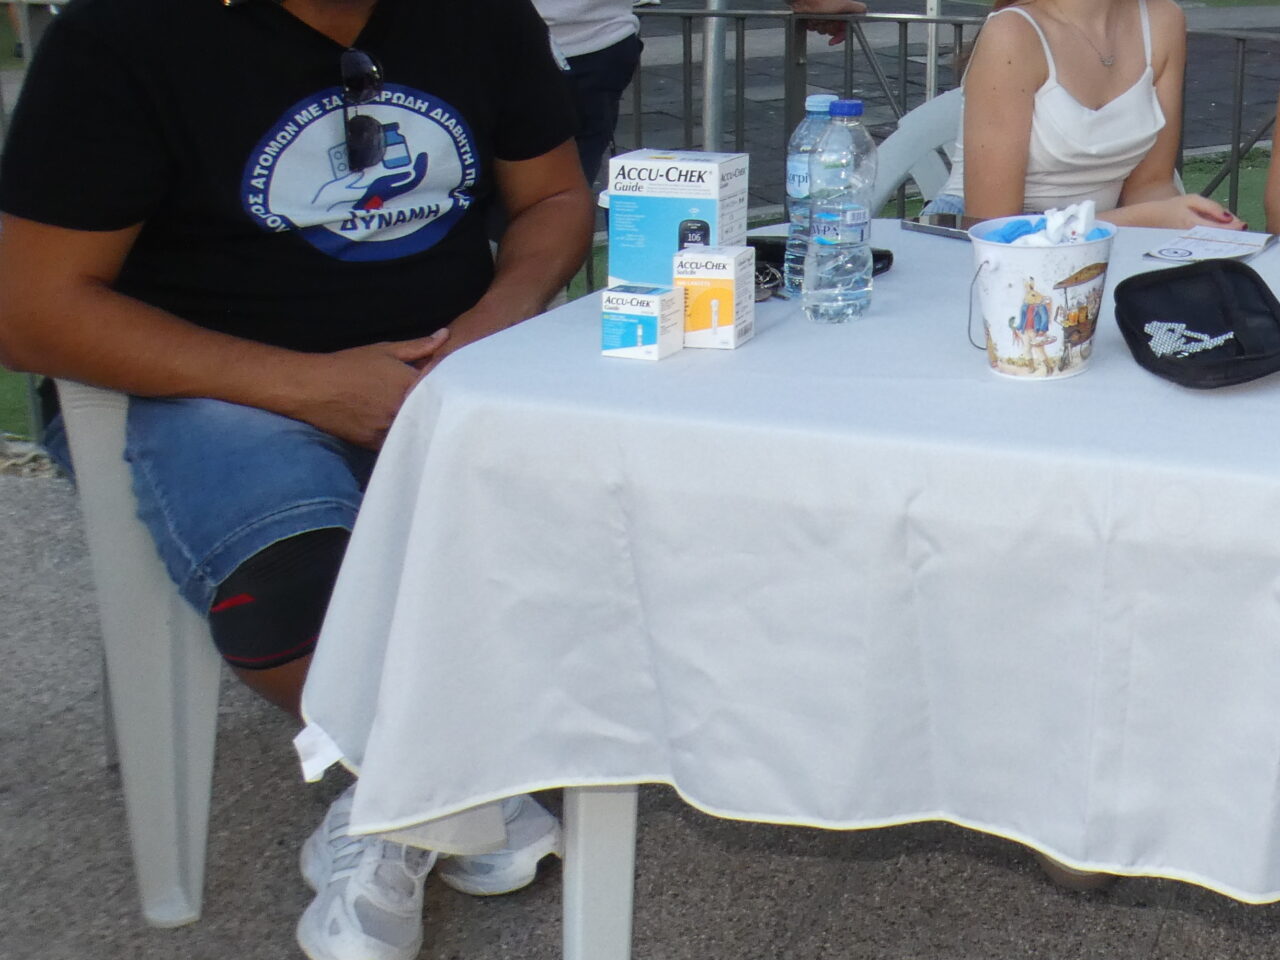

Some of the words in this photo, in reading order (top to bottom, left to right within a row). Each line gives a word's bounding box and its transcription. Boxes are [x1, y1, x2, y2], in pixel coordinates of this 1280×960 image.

[250, 120, 299, 189] ΑΤΟΜΩΝ
[294, 102, 324, 126] ΜΕ
[429, 107, 475, 166] ΔΙΑΒΗΤΗ
[614, 164, 708, 183] ACCU-CHEK
[614, 181, 644, 193] Guide
[340, 204, 440, 232] ΔΥΝΑΜΗ
[676, 260, 728, 271] ACCU-CHEK
[604, 295, 652, 308] ACCU-CHEK
